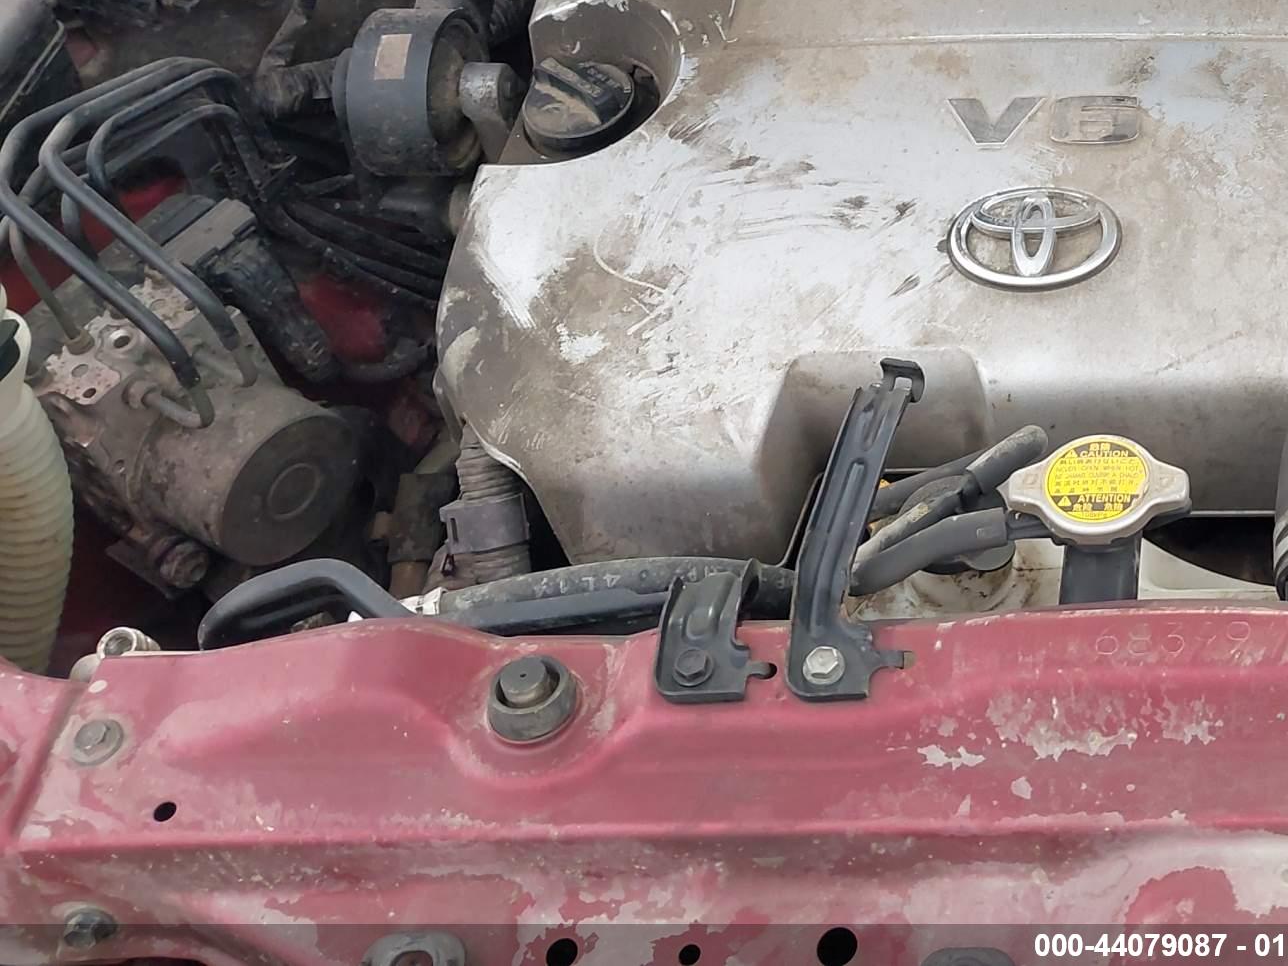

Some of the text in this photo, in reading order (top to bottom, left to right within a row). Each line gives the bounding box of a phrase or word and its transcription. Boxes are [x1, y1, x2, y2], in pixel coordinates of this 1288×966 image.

[946, 95, 1140, 147] V6
[1079, 449, 1129, 458] CAUTION
[1077, 494, 1131, 503] ATTENTION
